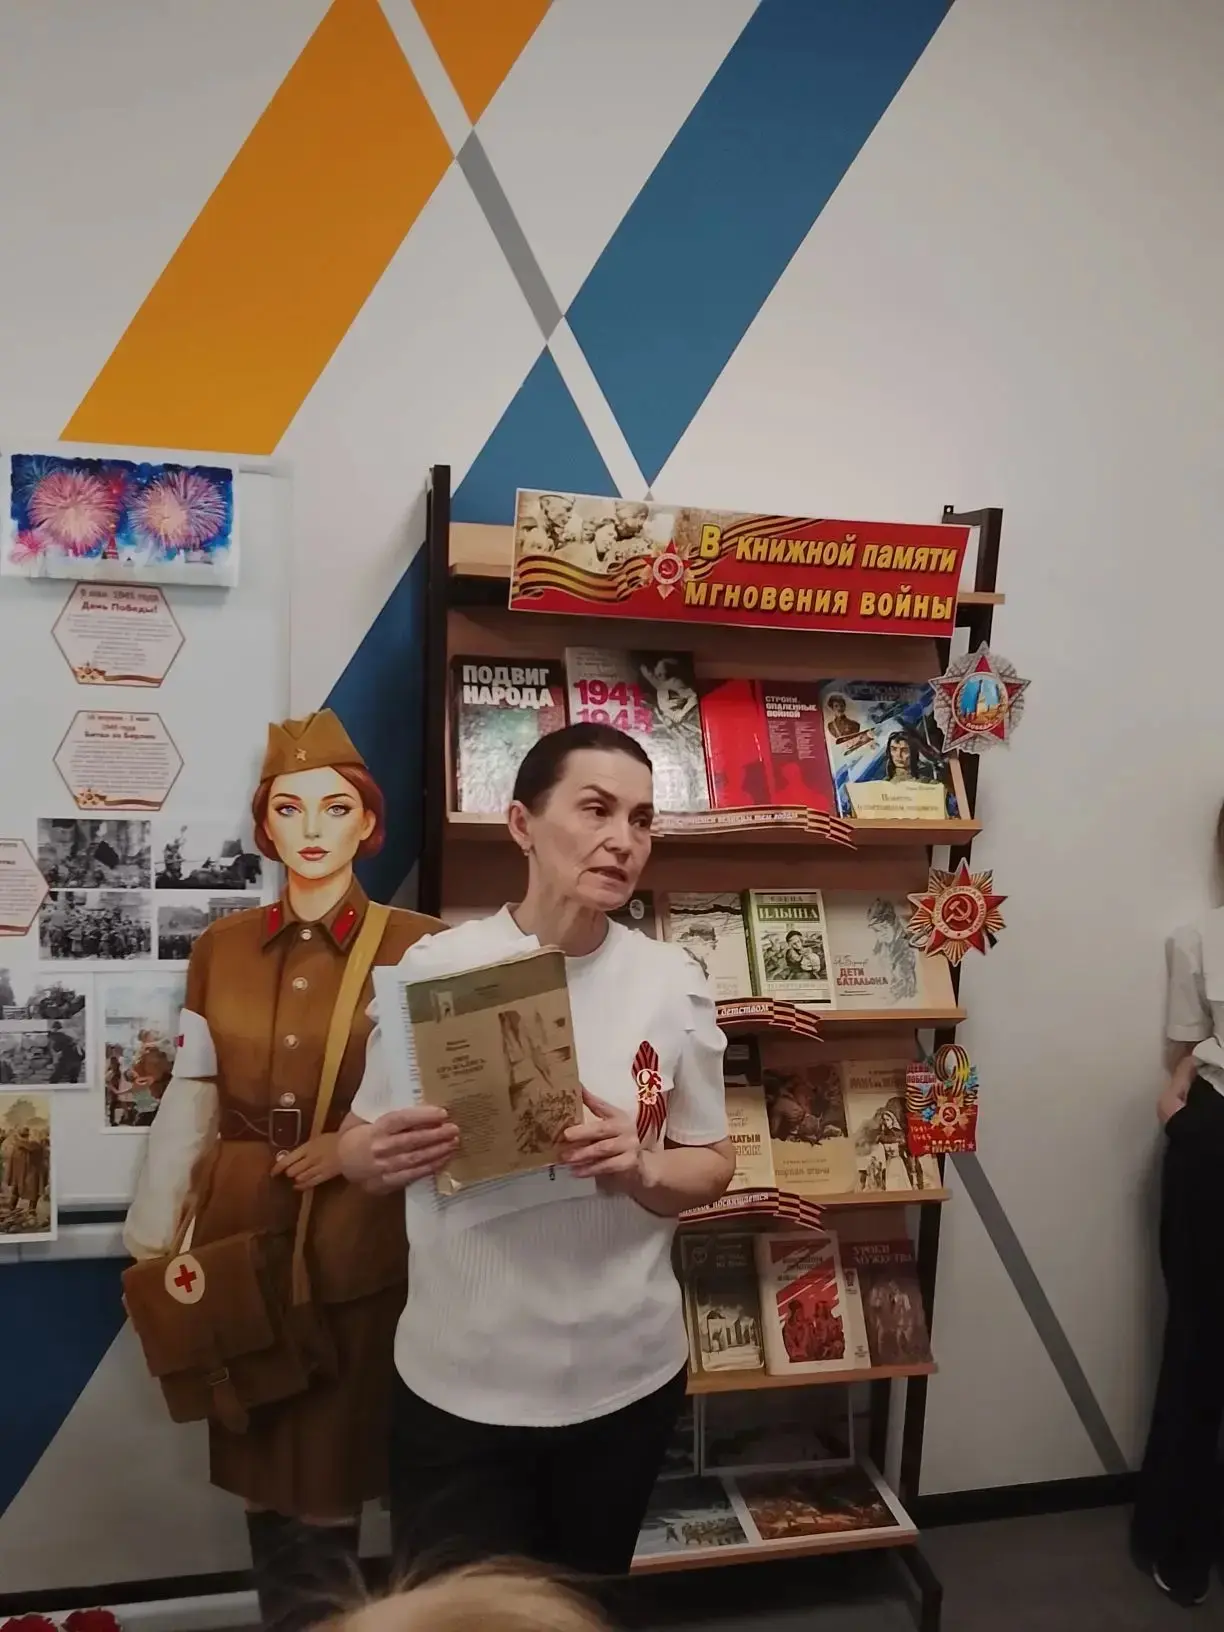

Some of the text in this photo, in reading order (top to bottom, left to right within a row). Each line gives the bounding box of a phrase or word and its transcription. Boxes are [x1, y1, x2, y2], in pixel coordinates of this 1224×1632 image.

[700, 523, 957, 573] В книжной памяти
[81, 601, 108, 611] День
[684, 581, 953, 620] мгновения войны
[462, 664, 550, 687] ПОДВИГ
[463, 685, 555, 709] НАРОДА
[573, 679, 642, 708] 1941
[759, 907, 819, 920] ИЛЬИНА
[836, 976, 889, 986] БАТАЛЬОНА
[839, 967, 865, 978] ДЕТИ
[721, 1004, 769, 1016] детством
